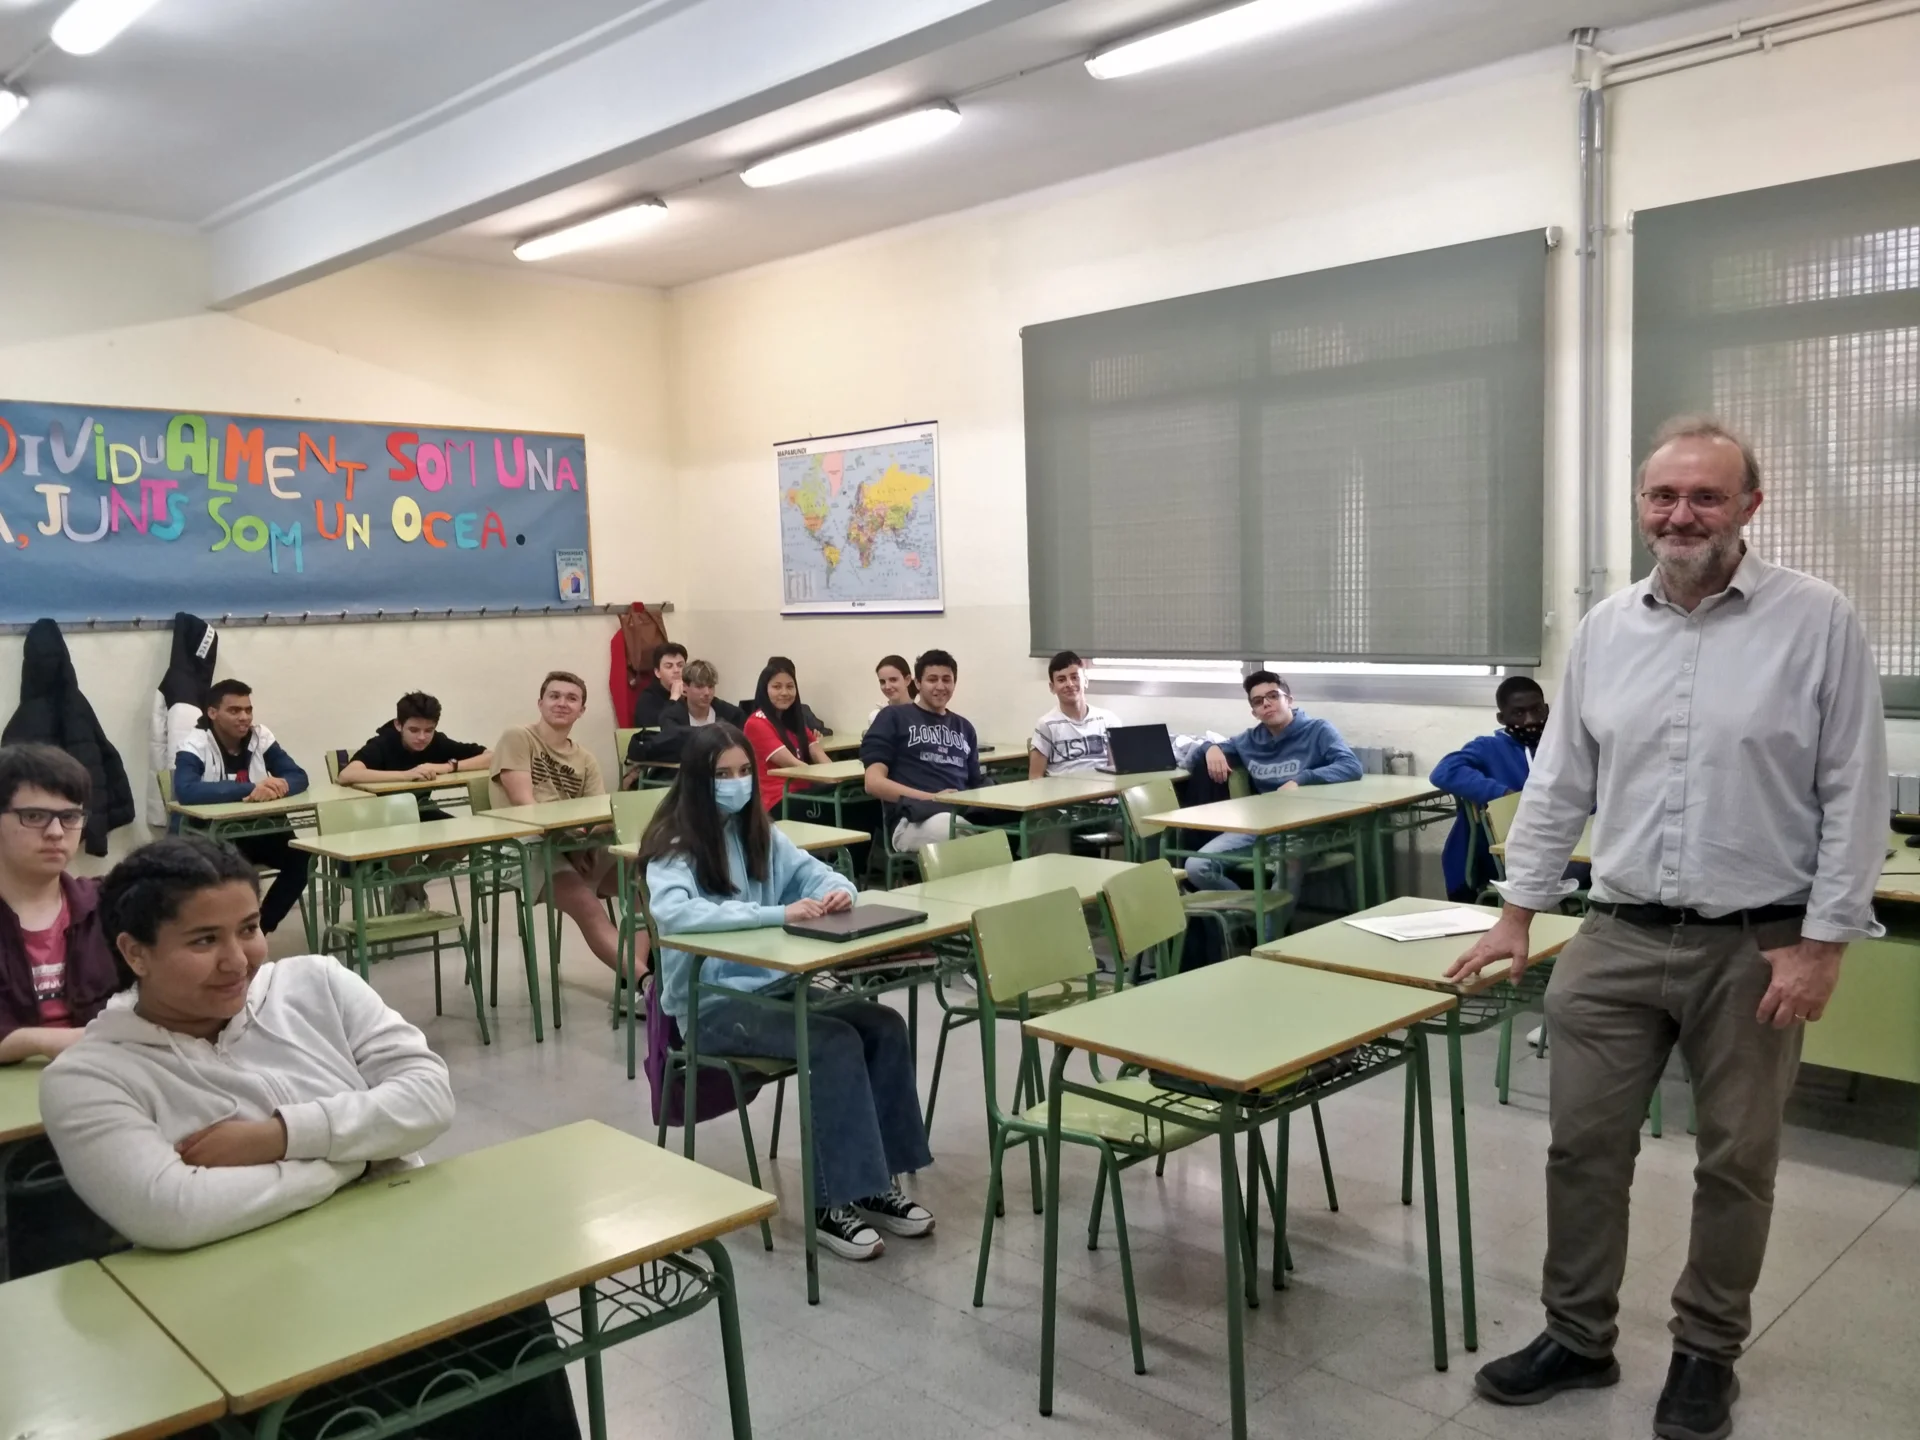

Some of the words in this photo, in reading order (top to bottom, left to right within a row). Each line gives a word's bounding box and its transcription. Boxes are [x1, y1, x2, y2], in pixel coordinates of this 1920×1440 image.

[386, 431, 477, 492] SOM
[494, 436, 579, 491] UNA
[34, 479, 189, 542] JUNTS
[208, 496, 304, 574] SOM
[315, 499, 371, 550] UN
[1251, 762, 1297, 776] RELATED
